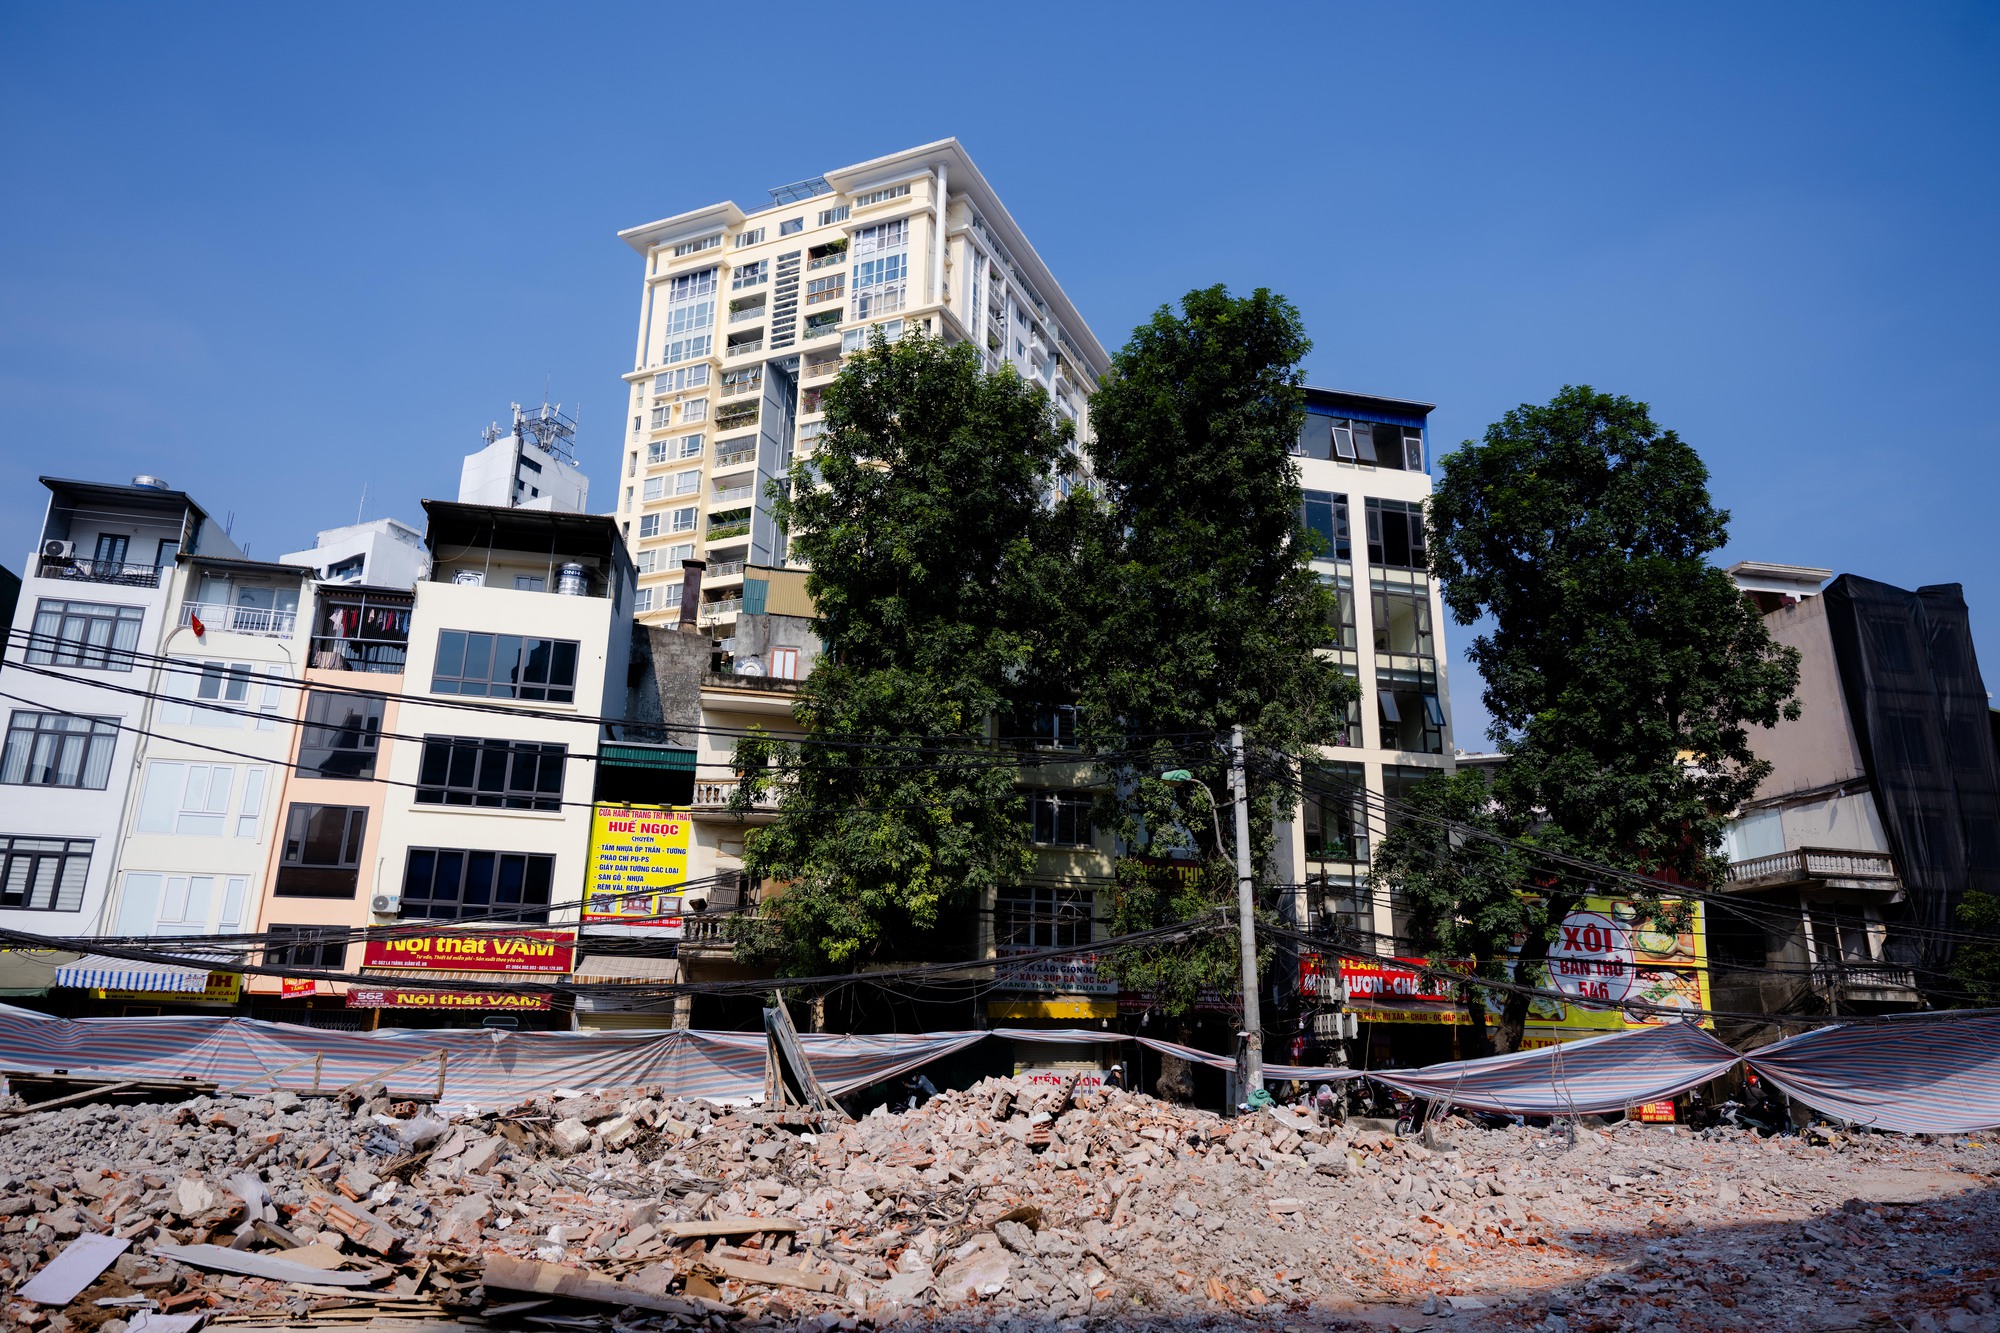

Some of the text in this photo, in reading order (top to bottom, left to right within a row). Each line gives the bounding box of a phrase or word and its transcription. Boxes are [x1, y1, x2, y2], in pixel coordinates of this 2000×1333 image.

[612, 808, 630, 818] HÀNG
[631, 810, 652, 819] TRANG
[608, 819, 678, 836] HUẾ NGỌC
[602, 843, 614, 851] TẤM
[644, 846, 660, 854] TRẦN
[599, 862, 614, 870] GIẤY
[1562, 922, 1612, 953] XÔI
[493, 938, 555, 956] VAM
[1560, 954, 1624, 976] BÀN THỜ
[1064, 974, 1075, 982] GÀ
[1578, 982, 1609, 1000] 546
[397, 994, 435, 1005] Nội
[440, 994, 483, 1005] thất
[487, 995, 541, 1006] VAM
